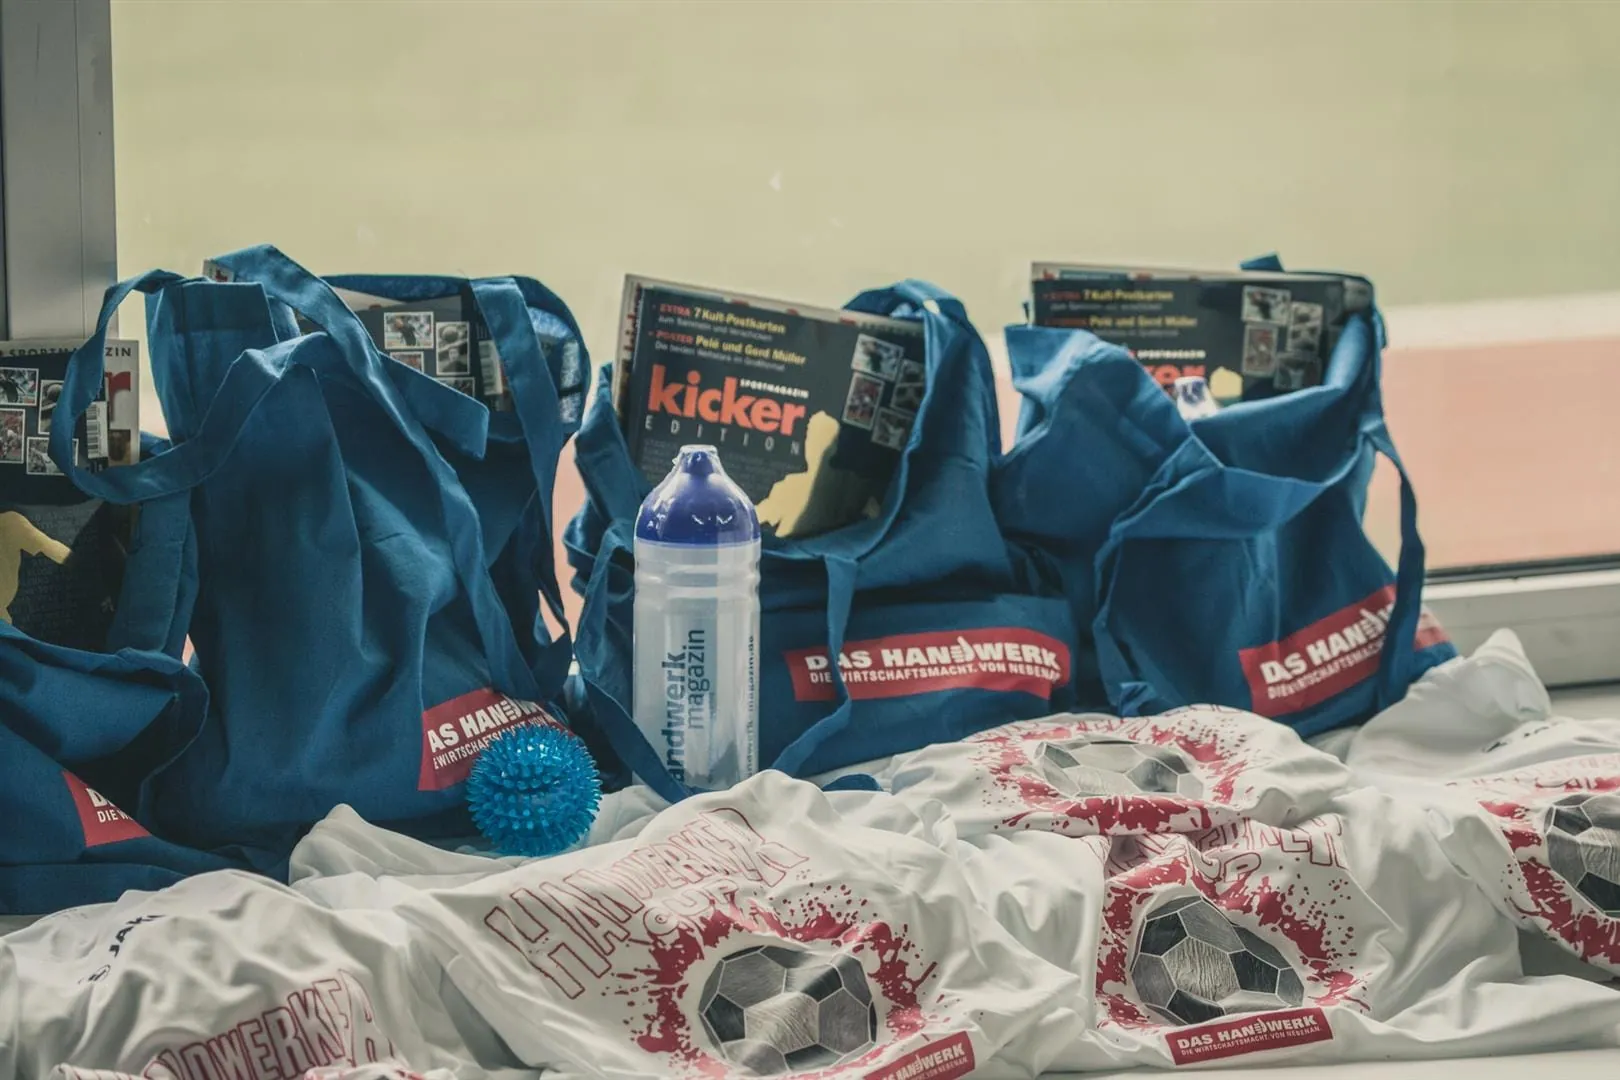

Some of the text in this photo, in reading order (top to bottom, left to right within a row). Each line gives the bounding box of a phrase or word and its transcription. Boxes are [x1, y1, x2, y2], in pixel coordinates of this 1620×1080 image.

[694, 306, 701, 319] 7
[702, 308, 786, 335] Kult-Postkarten
[722, 342, 742, 354] und
[649, 365, 806, 435] kicker
[740, 378, 809, 399] SPORTMAGAZIN
[645, 415, 800, 455] EDITION
[881, 636, 1062, 671] HANDWERK
[683, 629, 711, 730] magazin
[810, 671, 833, 684] DIE
[978, 661, 1006, 673] VON
[661, 652, 686, 783] andwerk
[427, 723, 460, 753] AS
[96, 808, 119, 823] DIE
[1176, 1014, 1318, 1050] DAS HANDWERK
[1181, 1048, 1194, 1056] DIE
[1270, 1031, 1285, 1040] VON
[895, 1042, 965, 1080] HANDWERK
